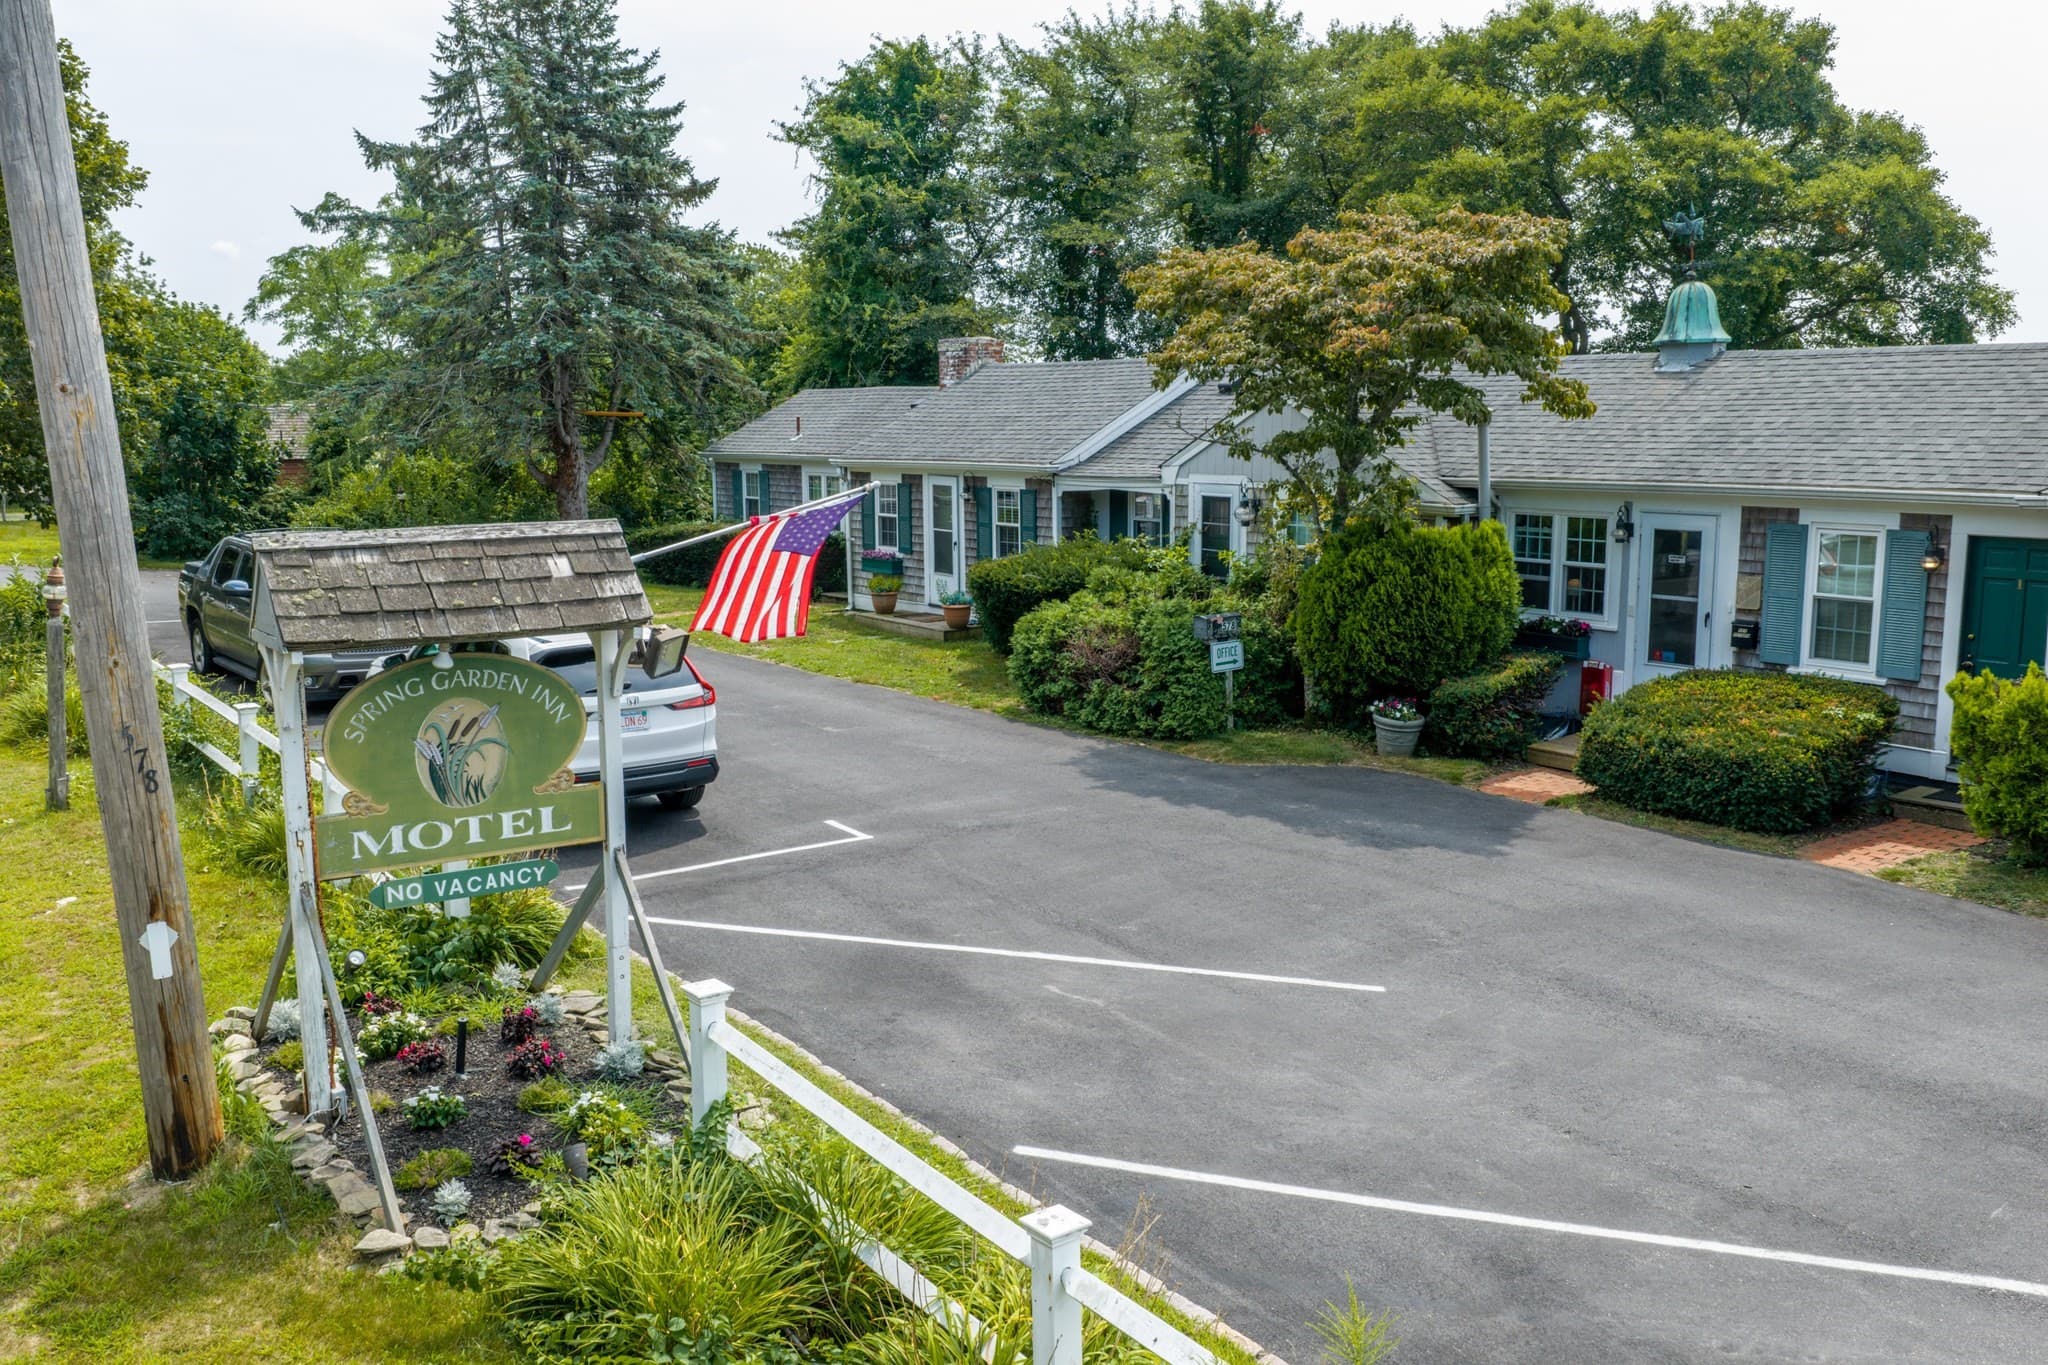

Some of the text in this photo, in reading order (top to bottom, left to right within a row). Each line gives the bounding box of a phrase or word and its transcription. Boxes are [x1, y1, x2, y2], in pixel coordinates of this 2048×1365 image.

[1216, 645, 1238, 659] OFFICE
[344, 669, 571, 744] SPRING GARDEN INN
[350, 806, 573, 860] MOTEL
[387, 866, 546, 904] NO VACANCY
